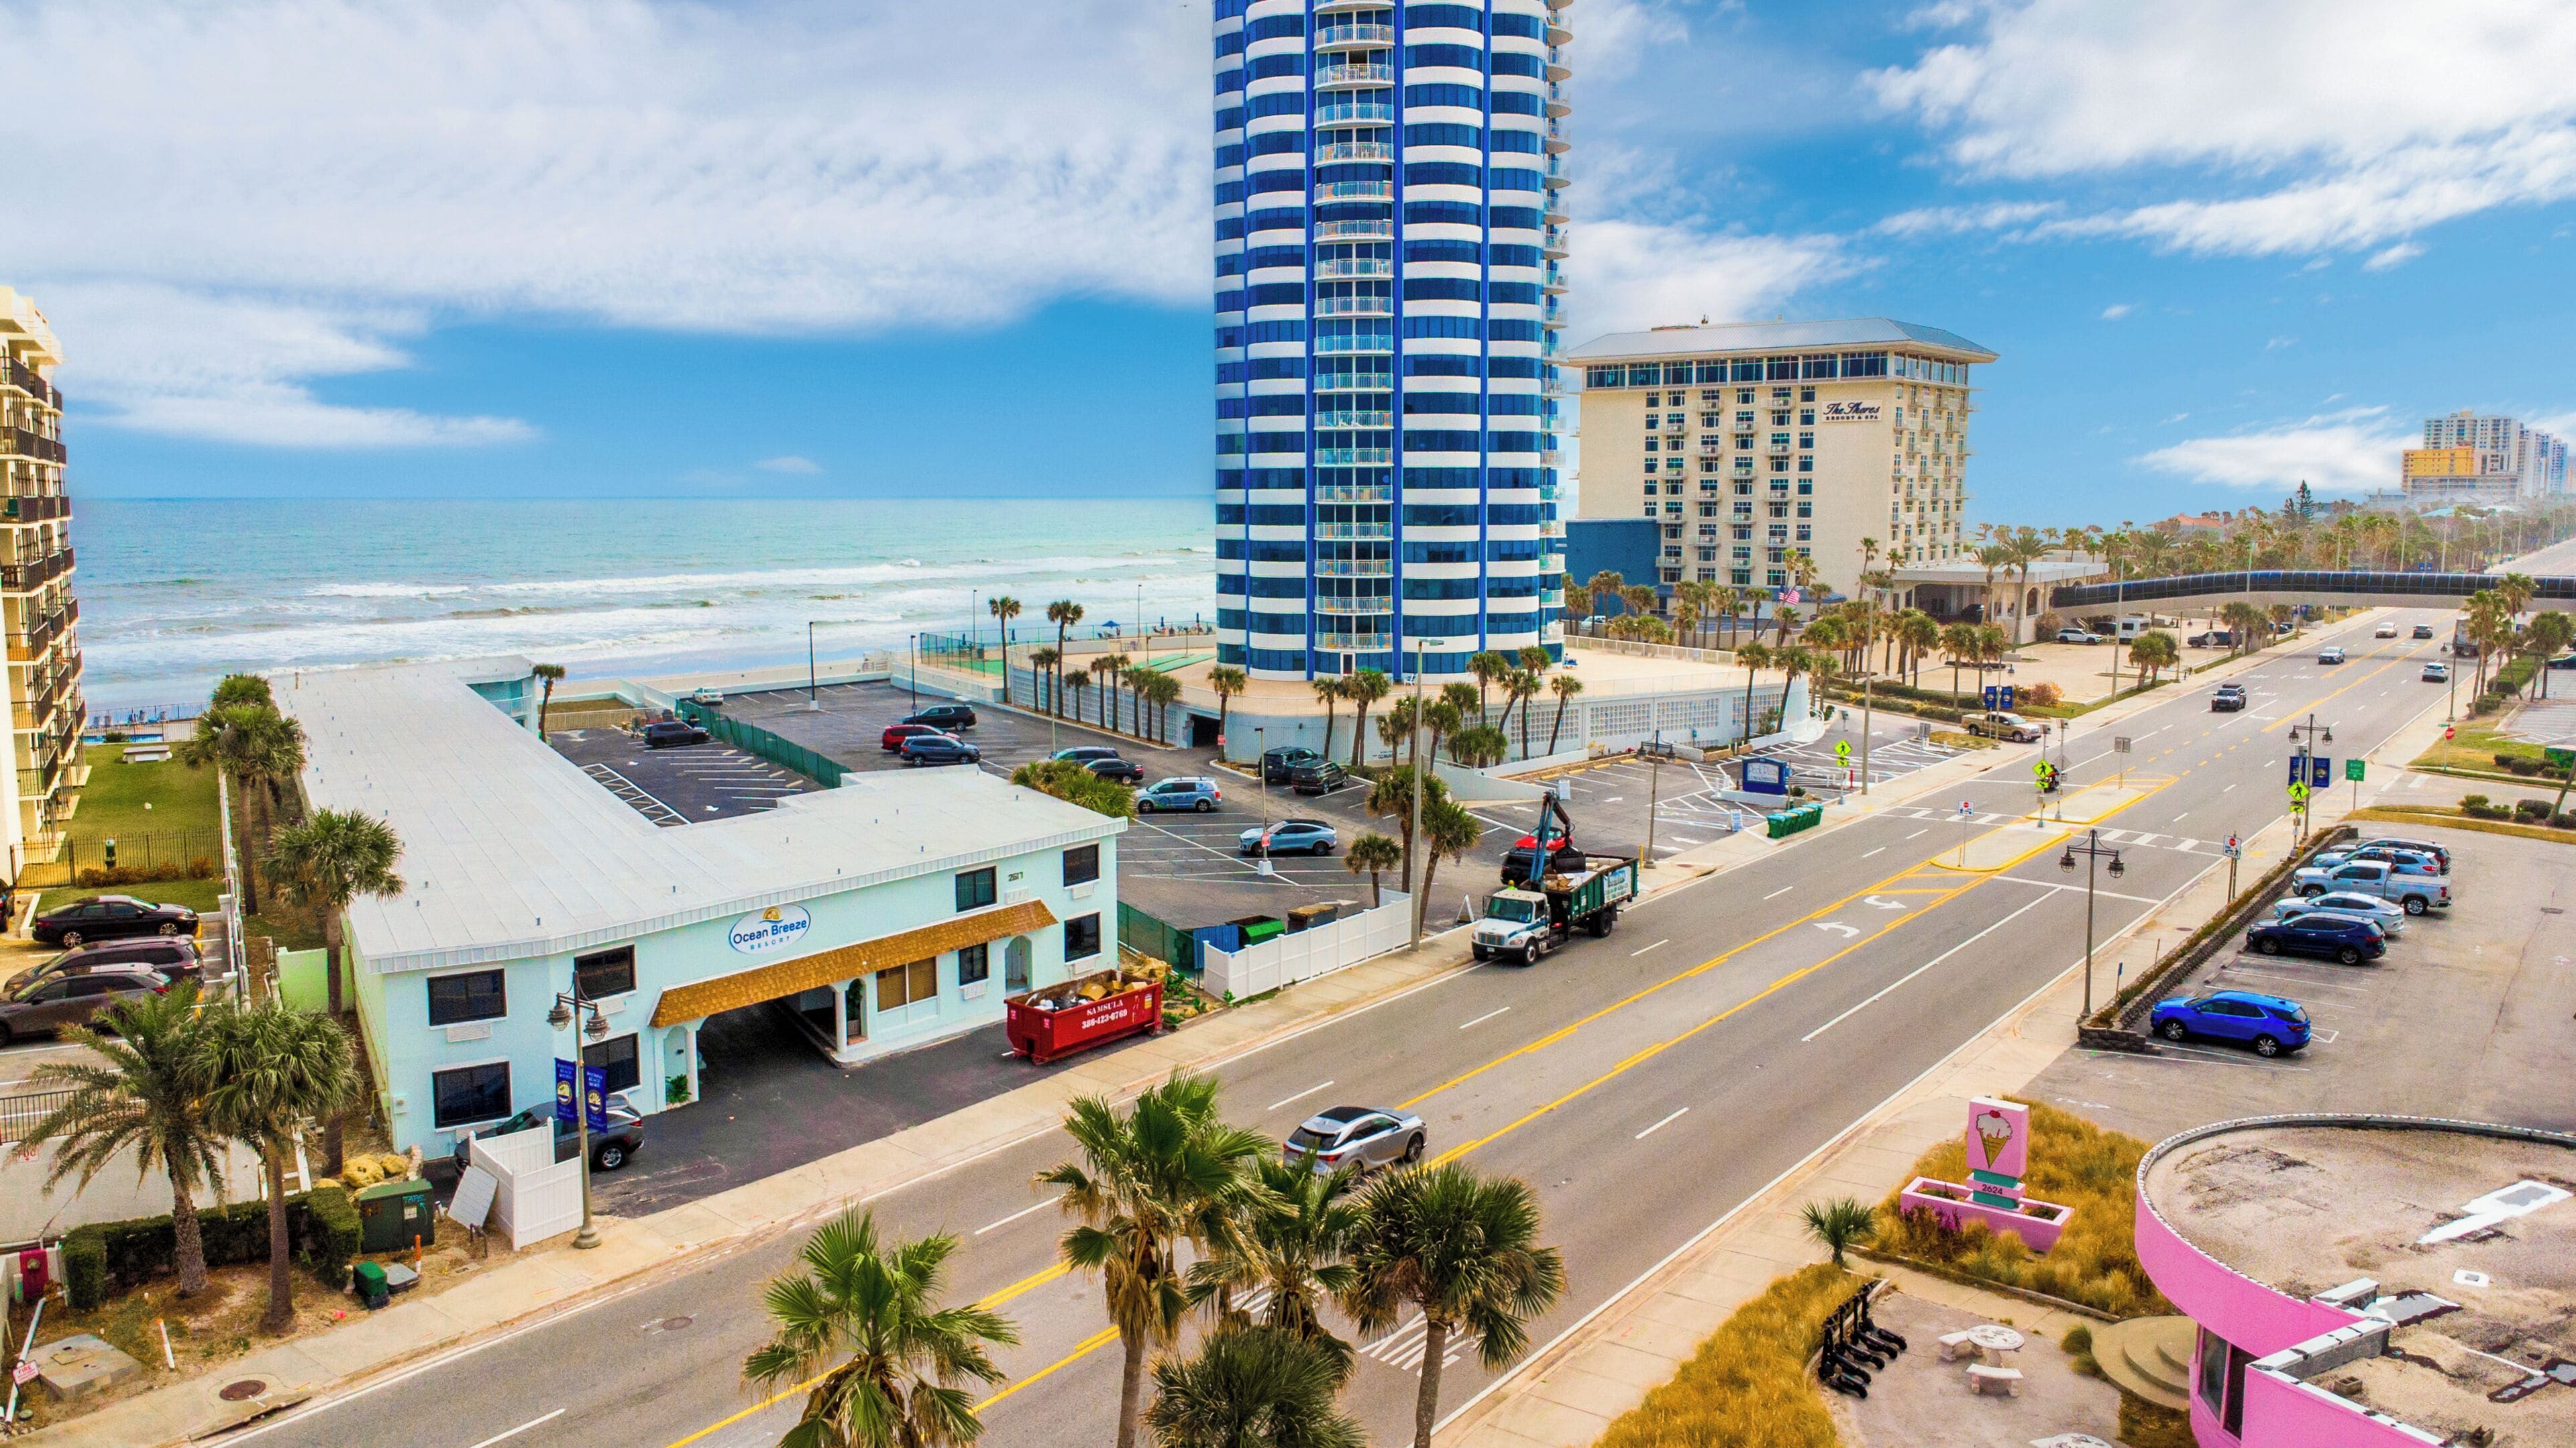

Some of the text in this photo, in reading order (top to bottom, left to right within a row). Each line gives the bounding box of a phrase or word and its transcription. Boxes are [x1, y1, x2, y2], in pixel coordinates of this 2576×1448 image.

[1823, 401, 1880, 415] The Shores
[733, 920, 807, 944] Ocean Breeze
[750, 936, 790, 950] RESORT
[1086, 998, 1124, 1016] SAMSULA
[1982, 1184, 2003, 1195] 2624
[402, 1194, 426, 1204] TAPE
